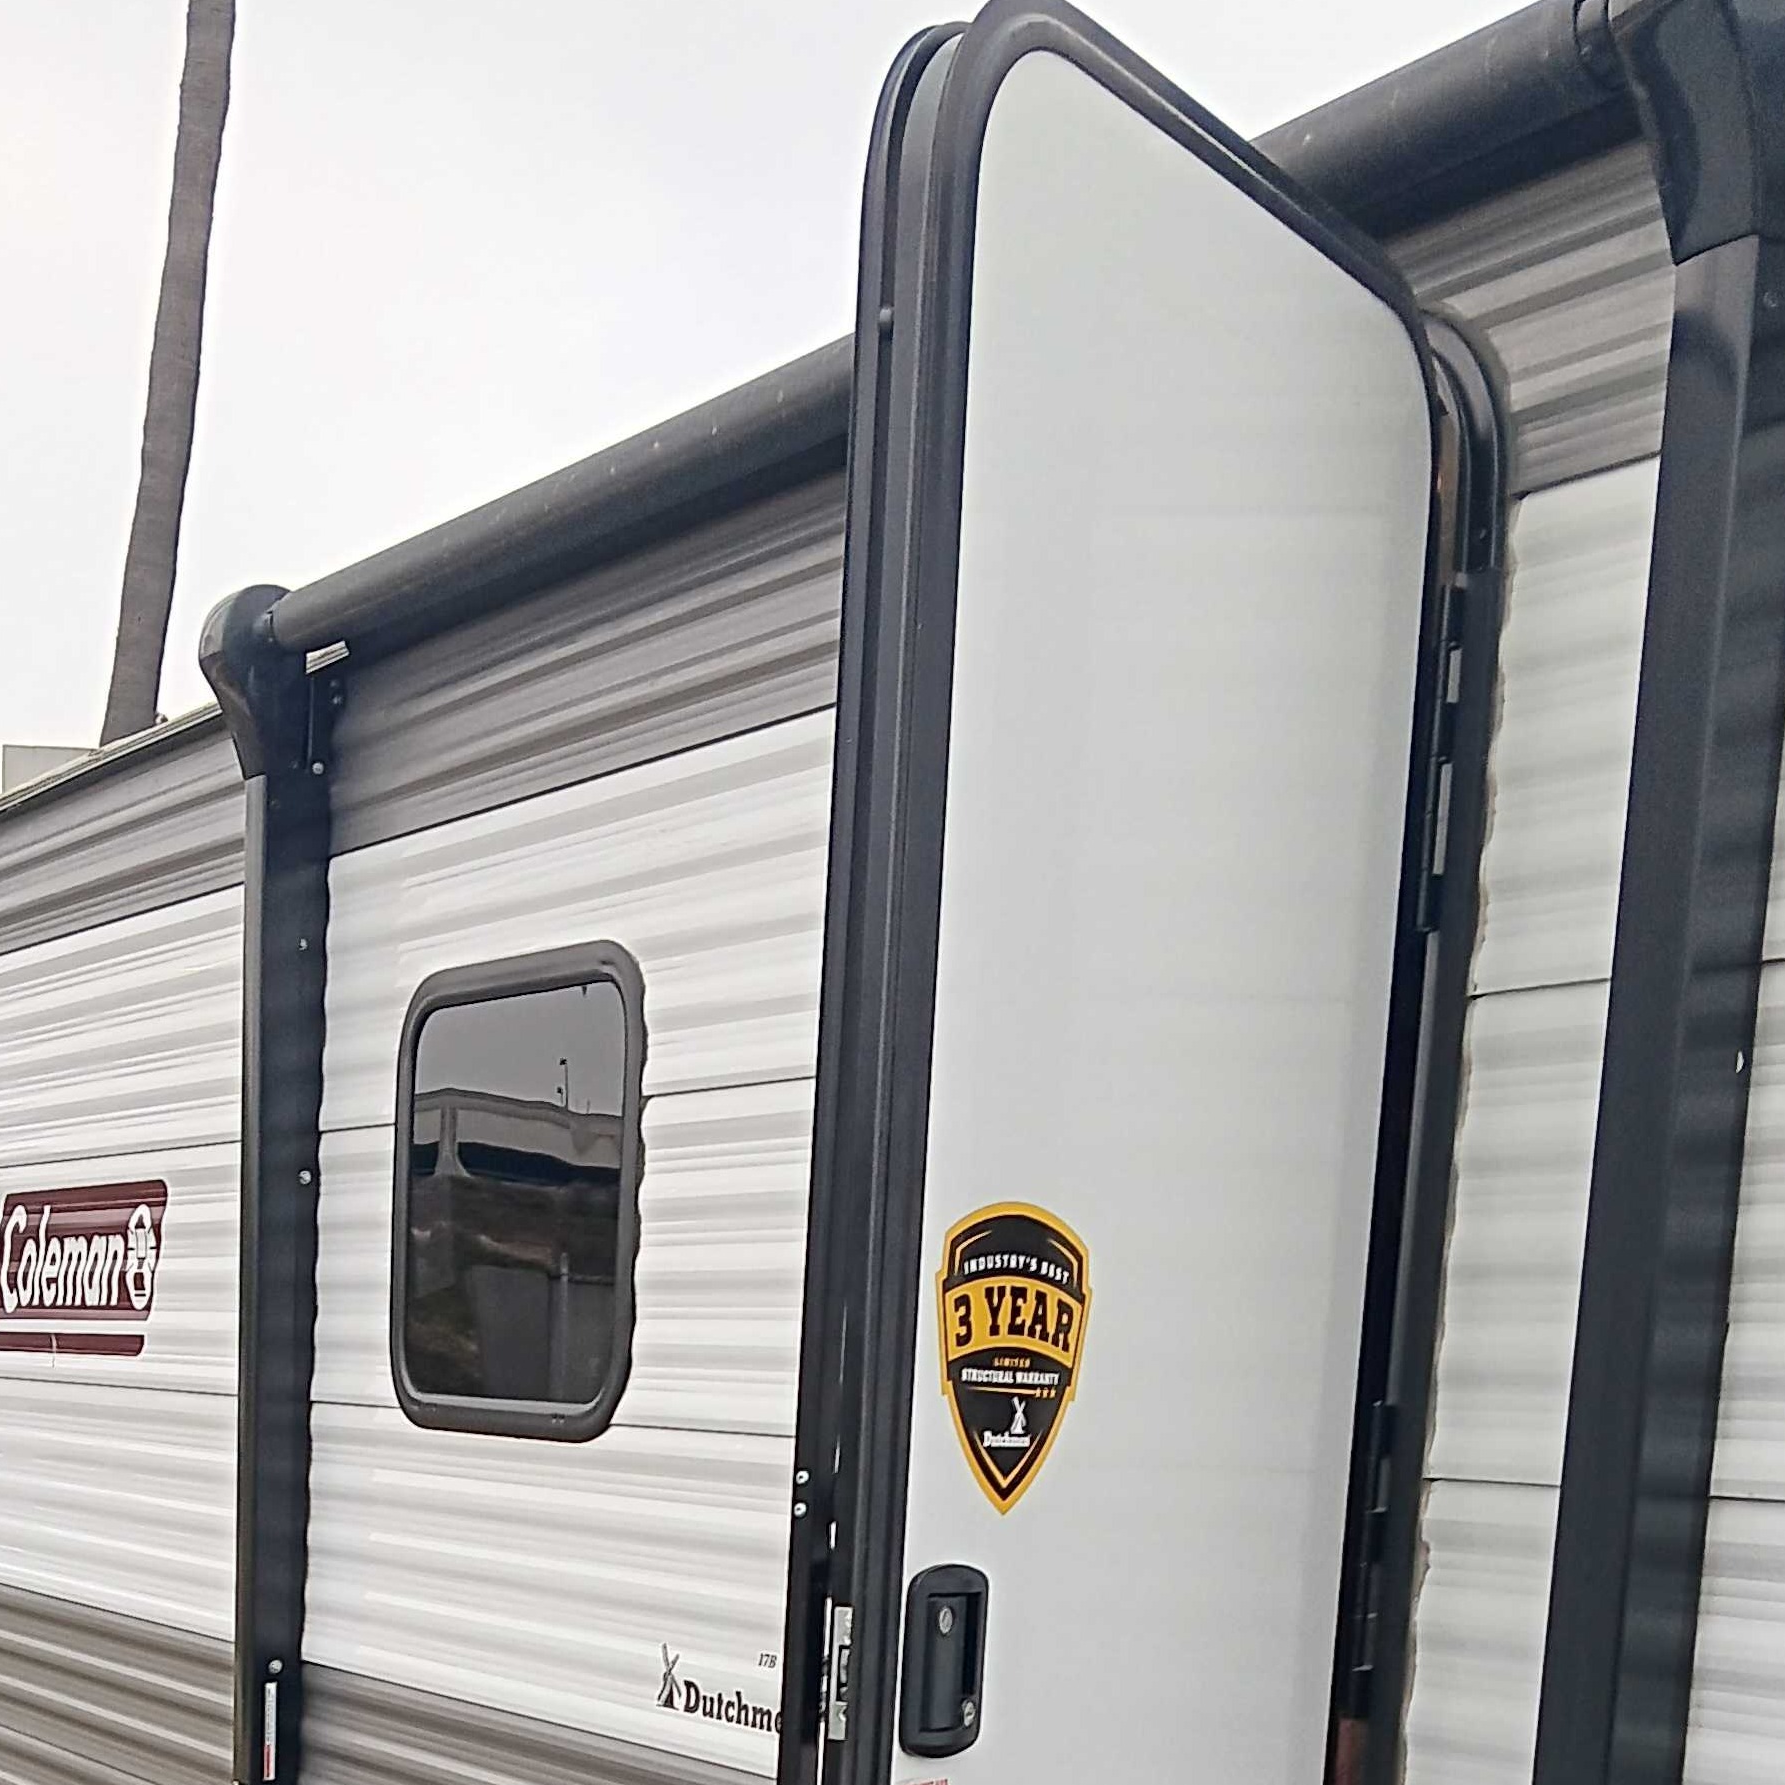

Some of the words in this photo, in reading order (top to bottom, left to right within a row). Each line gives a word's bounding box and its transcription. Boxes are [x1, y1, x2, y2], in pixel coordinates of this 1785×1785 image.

[0, 1204, 125, 1313] Coleman
[963, 1253, 1038, 1275] INDUSTRY'S
[1040, 1261, 1070, 1285] BEST
[953, 1293, 972, 1347] 3
[984, 1285, 1074, 1353] YEAR
[961, 1367, 1015, 1384] STRUCTURAL
[1015, 1371, 1060, 1385] WARRANTY
[758, 1652, 778, 1669] 17B
